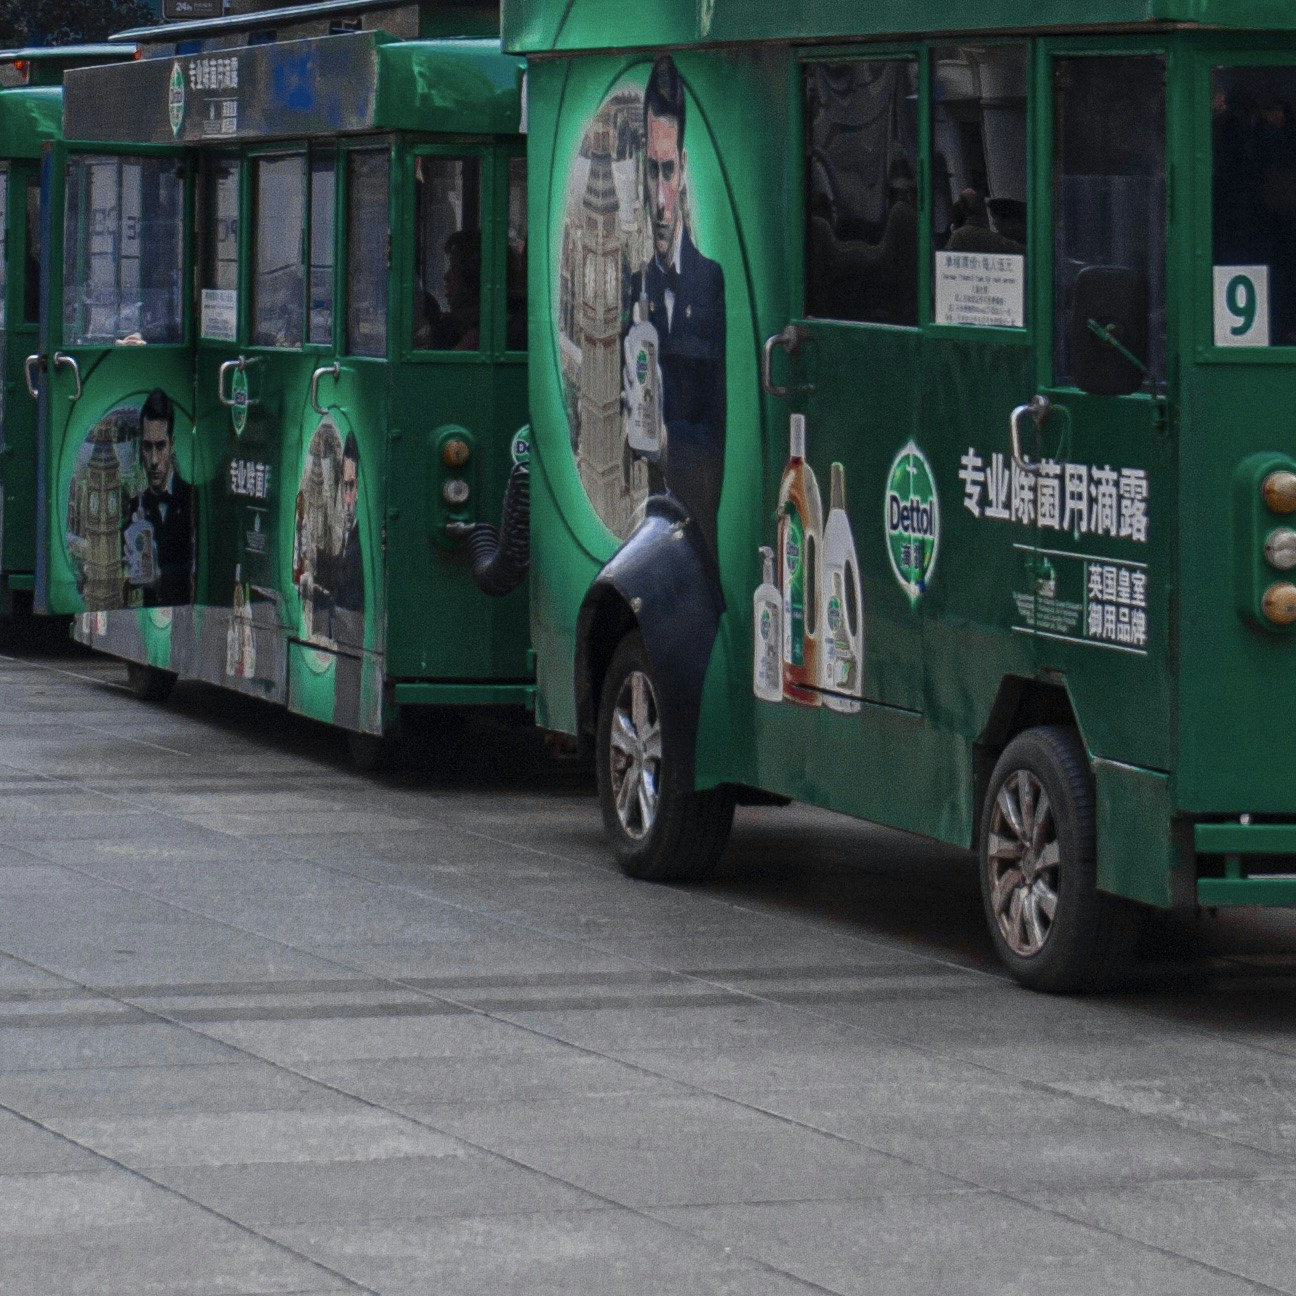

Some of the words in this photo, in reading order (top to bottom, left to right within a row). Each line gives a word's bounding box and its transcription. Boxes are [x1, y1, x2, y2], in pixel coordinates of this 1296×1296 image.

[1225, 272, 1257, 340] 9
[888, 492, 934, 536] Dettol
[958, 446, 1149, 543] 专业除菌用滴露
[1088, 562, 1147, 608] 英国皇室
[1088, 601, 1147, 646] 御用品牌
